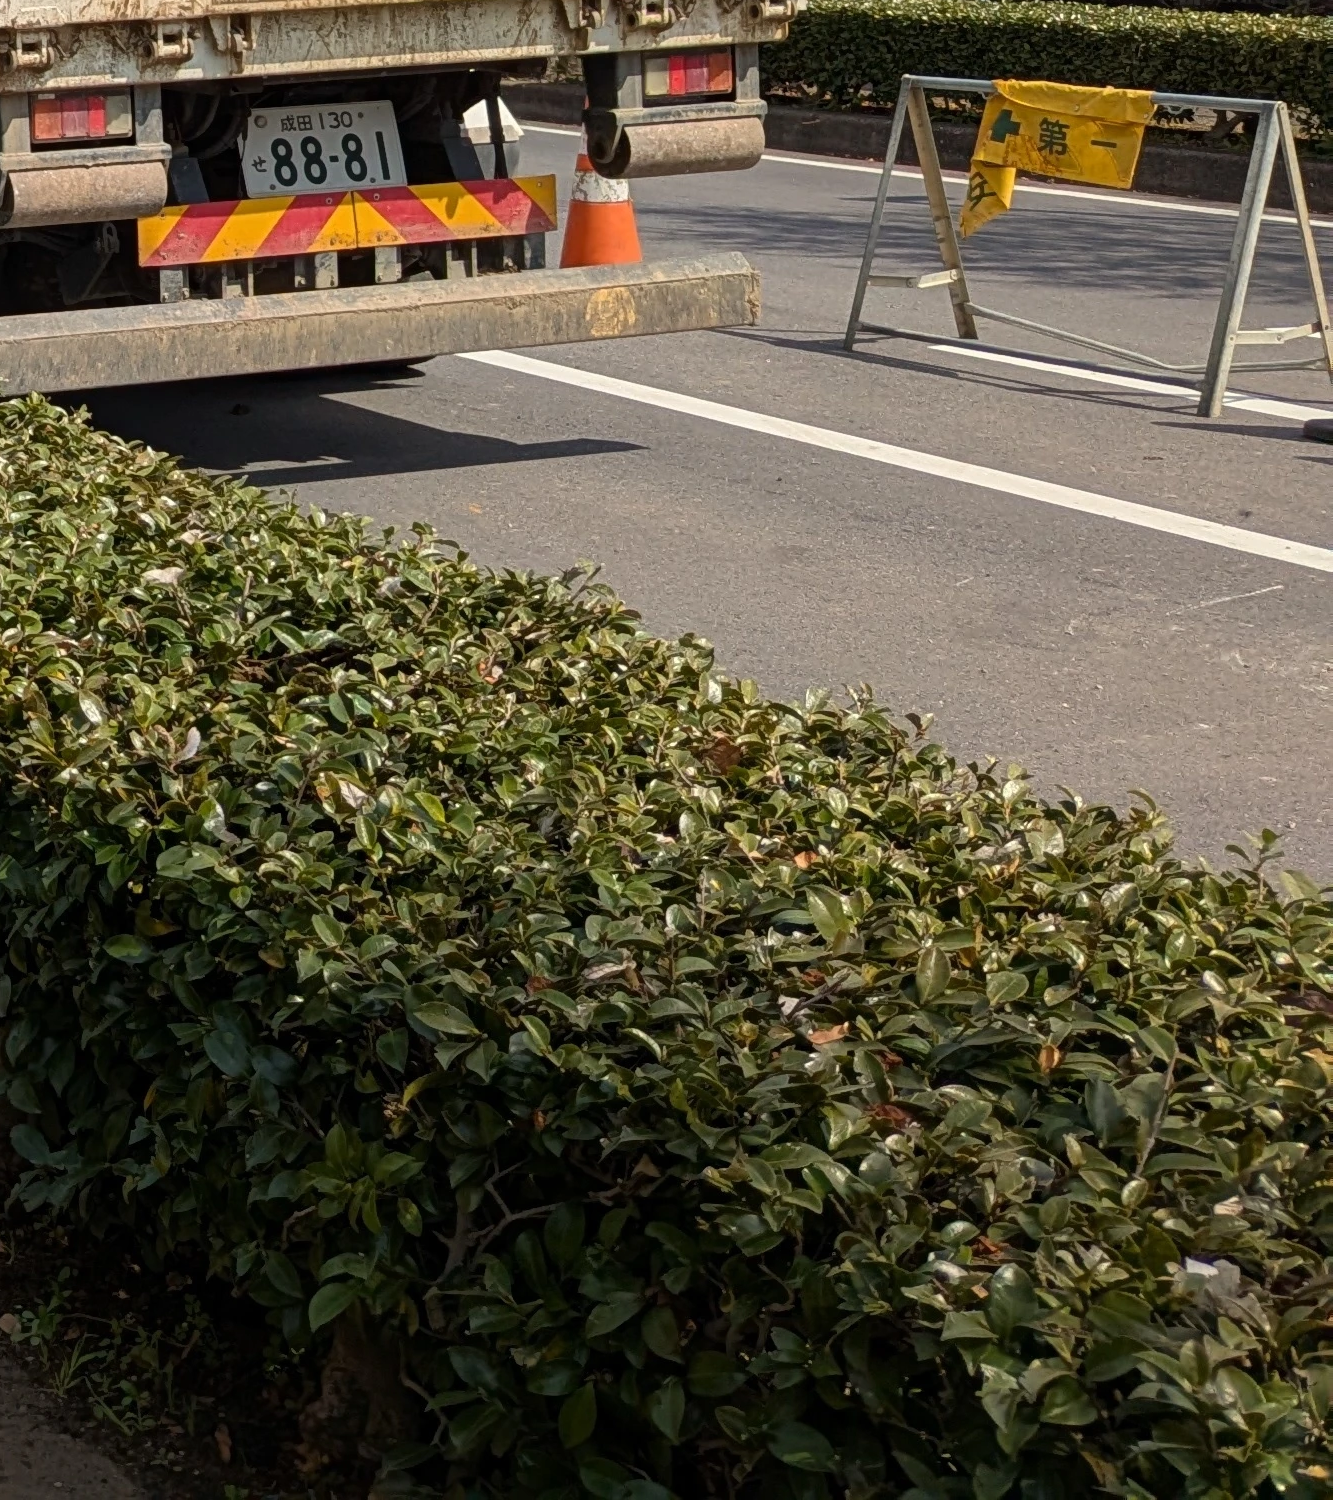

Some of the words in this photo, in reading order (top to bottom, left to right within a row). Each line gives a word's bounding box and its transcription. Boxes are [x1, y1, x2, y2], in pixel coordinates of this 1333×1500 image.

[280, 115, 313, 132] 成田
[318, 111, 353, 130] 130
[270, 130, 391, 187] 88-81
